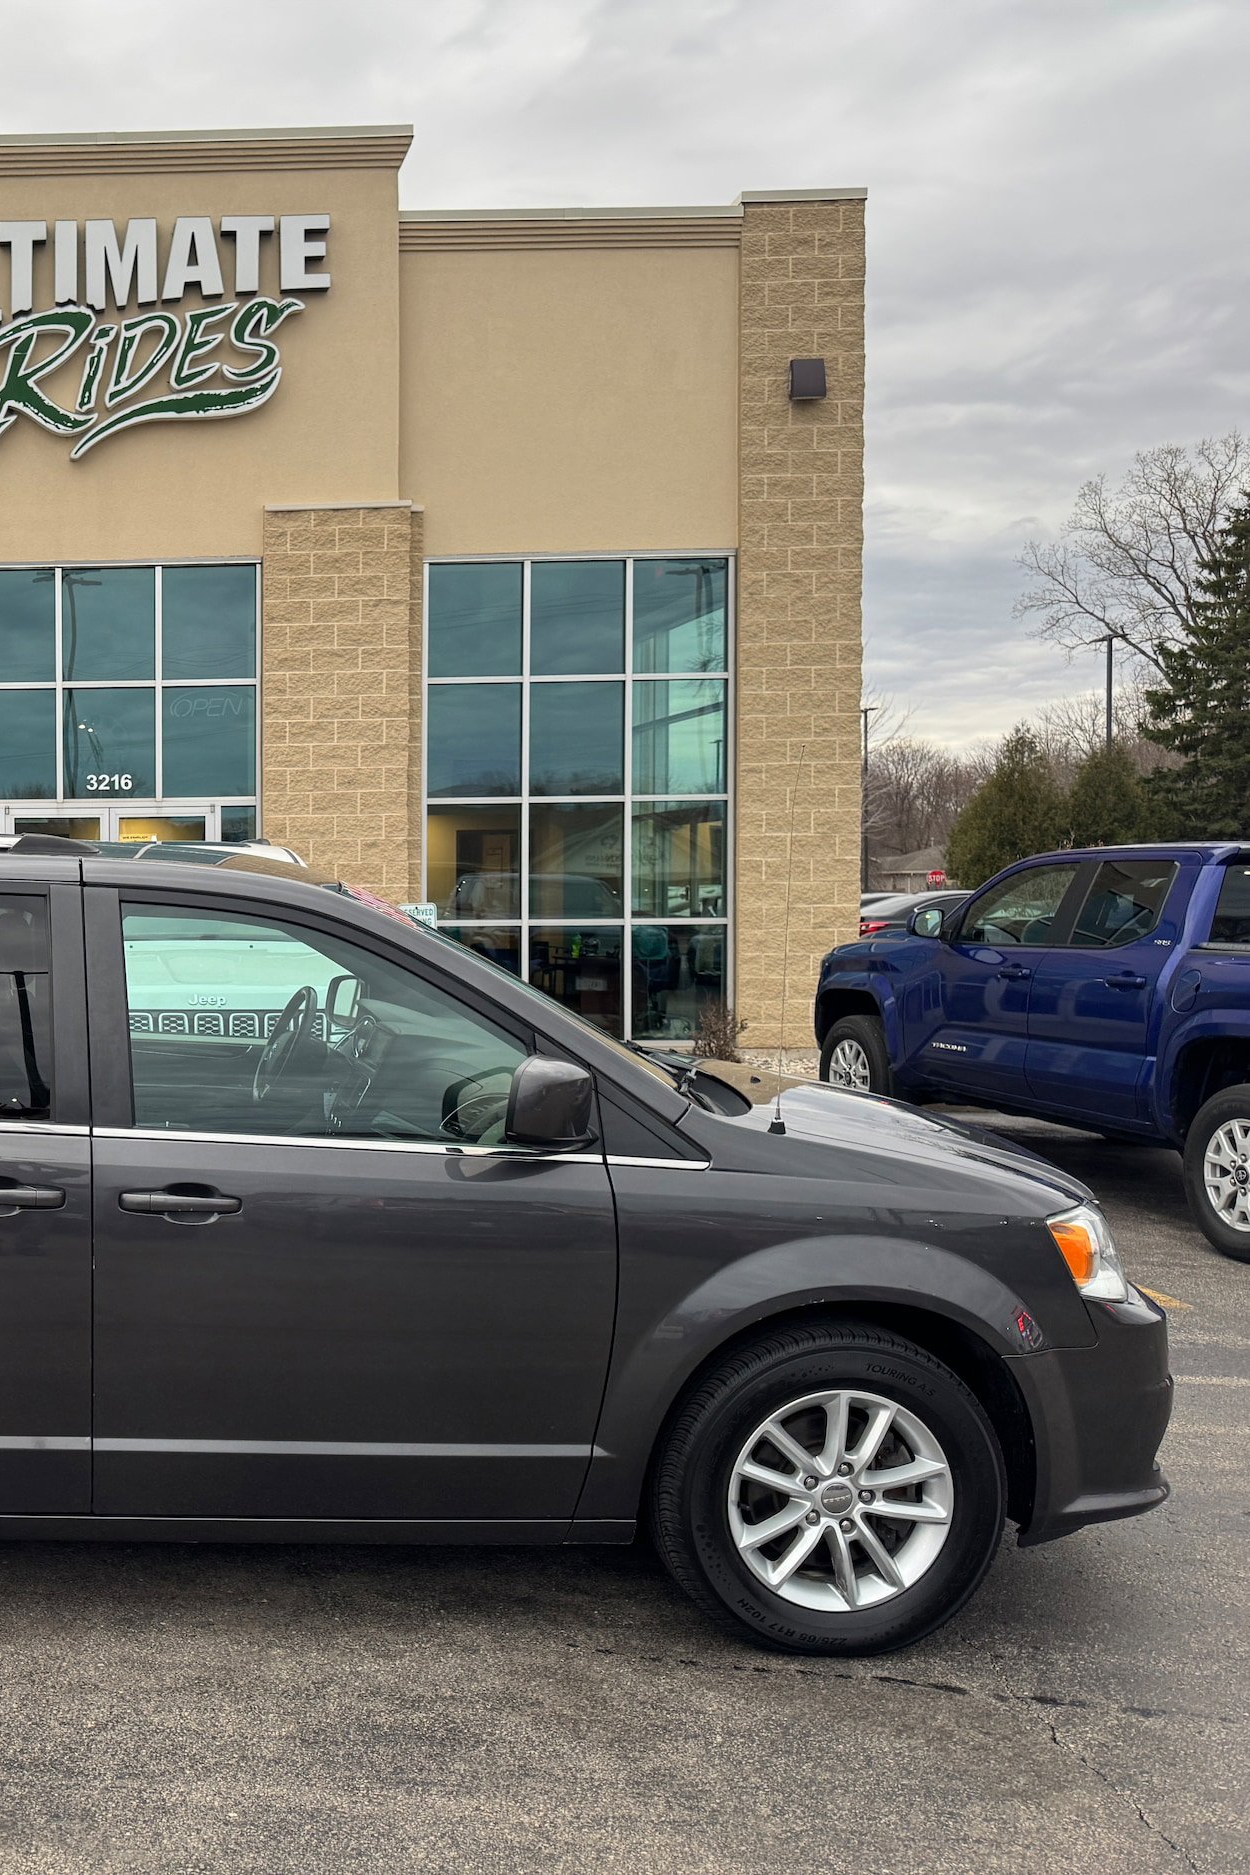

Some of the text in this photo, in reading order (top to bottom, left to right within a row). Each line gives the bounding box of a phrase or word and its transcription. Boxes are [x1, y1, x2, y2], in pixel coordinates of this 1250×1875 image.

[173, 698, 244, 717] OPEN
[86, 774, 133, 790] 3216
[927, 874, 946, 883] STOP
[404, 908, 434, 917] SERVED
[188, 993, 227, 1008] Jeep
[865, 1362, 919, 1386] TOURING
[736, 1597, 848, 1647] 225/65 R17 102H
